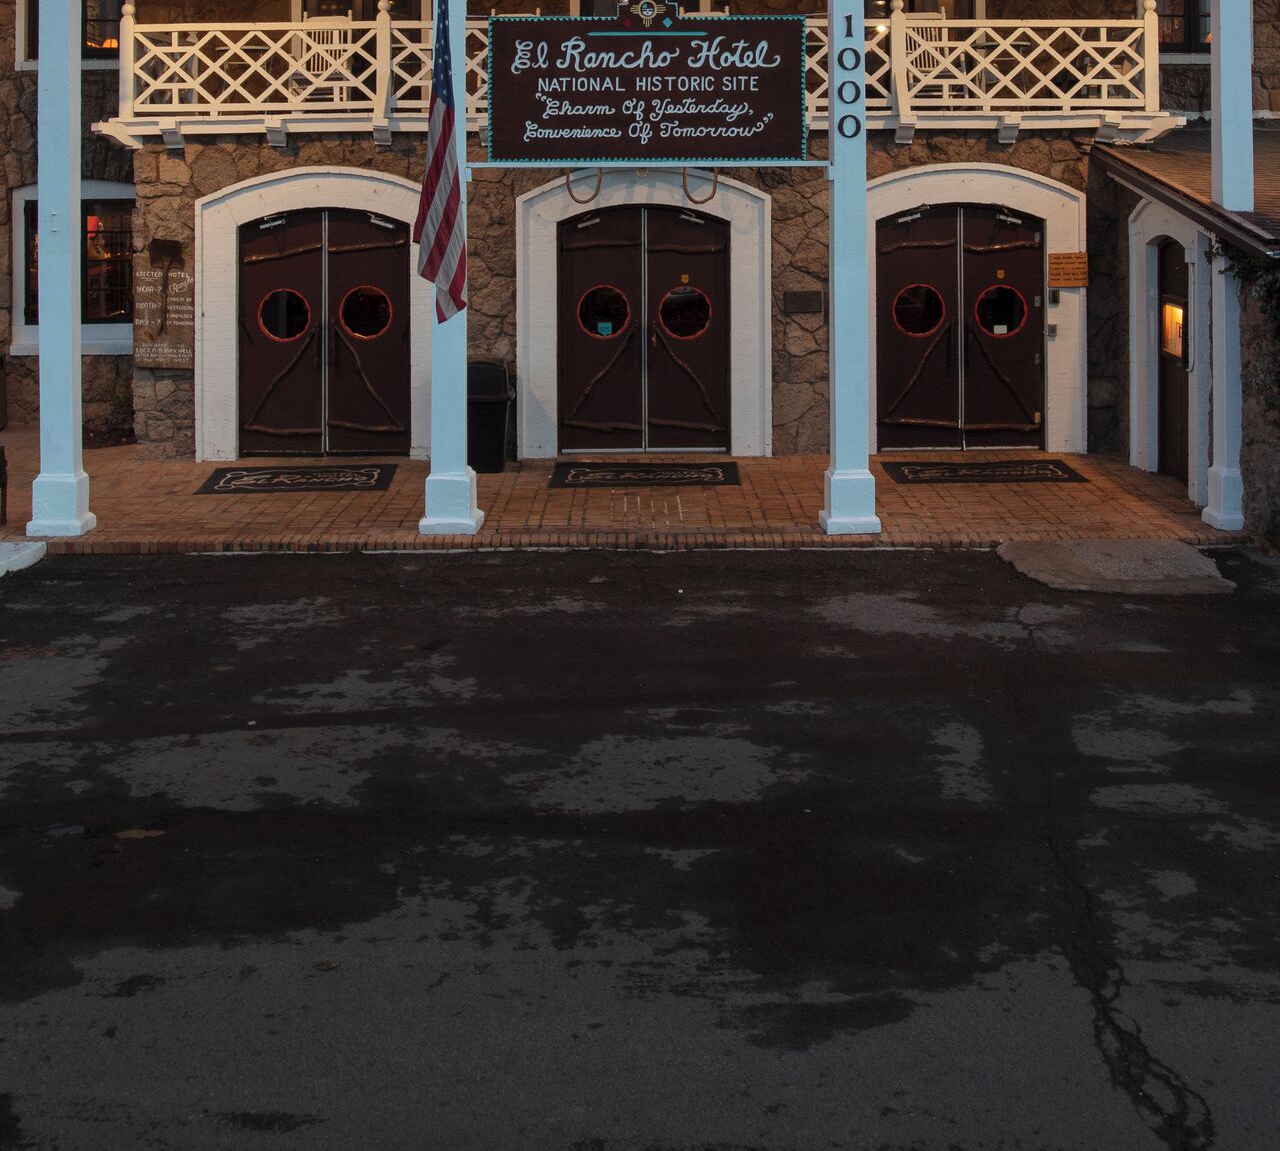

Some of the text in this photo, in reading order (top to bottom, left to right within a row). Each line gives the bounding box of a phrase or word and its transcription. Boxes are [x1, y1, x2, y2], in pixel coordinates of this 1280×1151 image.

[511, 36, 781, 74] El Rancho Hotel
[538, 76, 759, 92] NATIONAL HISTORIC SITE
[837, 13, 862, 139] 1000
[622, 98, 645, 121] Of
[650, 97, 754, 122] Yesterday,
[524, 120, 622, 142] Convenience
[628, 120, 653, 145] Of
